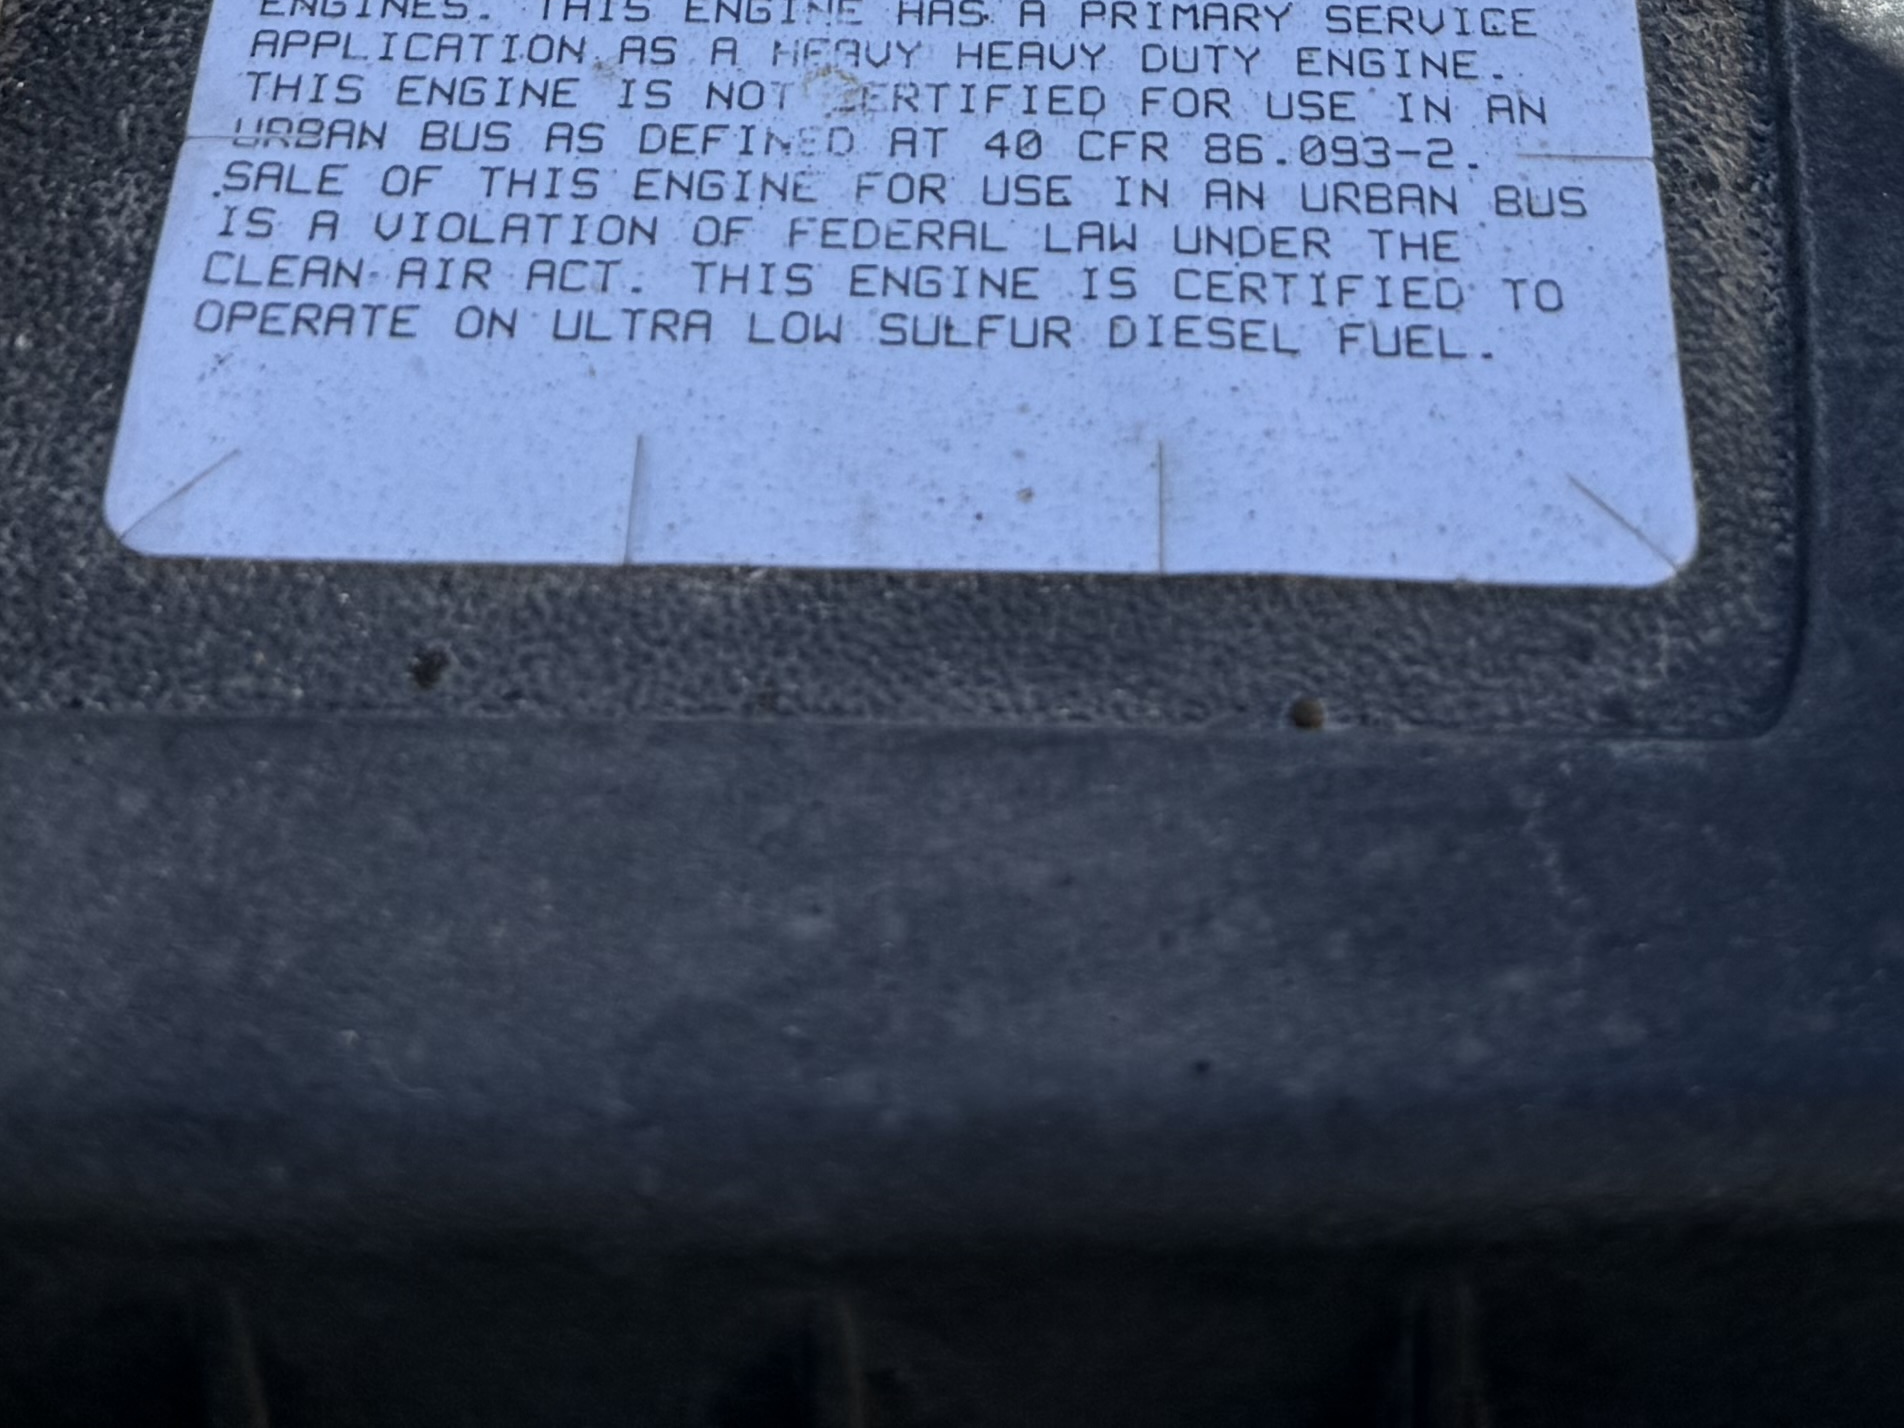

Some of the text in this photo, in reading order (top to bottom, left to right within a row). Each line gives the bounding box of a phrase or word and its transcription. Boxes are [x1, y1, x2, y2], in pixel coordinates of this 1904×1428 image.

[1324, 3, 1538, 38] SERVICE
[248, 28, 1504, 81] APPLICATION AS A HEAVY HEAVY DUTY ENGINE.
[245, 69, 365, 105] THIS
[394, 73, 580, 109] ENGINE
[616, 77, 673, 110] IS
[704, 79, 794, 111] NOT
[1140, 85, 1233, 121] FOR
[1265, 88, 1356, 124] USE
[1396, 91, 1452, 125] IN
[1485, 88, 1547, 126] AN
[225, 116, 1480, 171] URBAN BUS AS DEFINED AT 40 CFR 86.093-2.
[220, 159, 1588, 219] SALE OF THIS ENGINE FOR USE IN AN URBAN BUS
[216, 203, 1461, 264] IS A VIOLATION OF FEDERAL LAW UNDER THE
[200, 249, 1564, 314] CLEAN AIR ACT. THIS ENGINE IS CERTIFIED TO
[192, 298, 1494, 363] OPERATE ON ULTRA LOW SULFUR DIESEL FUEL.
